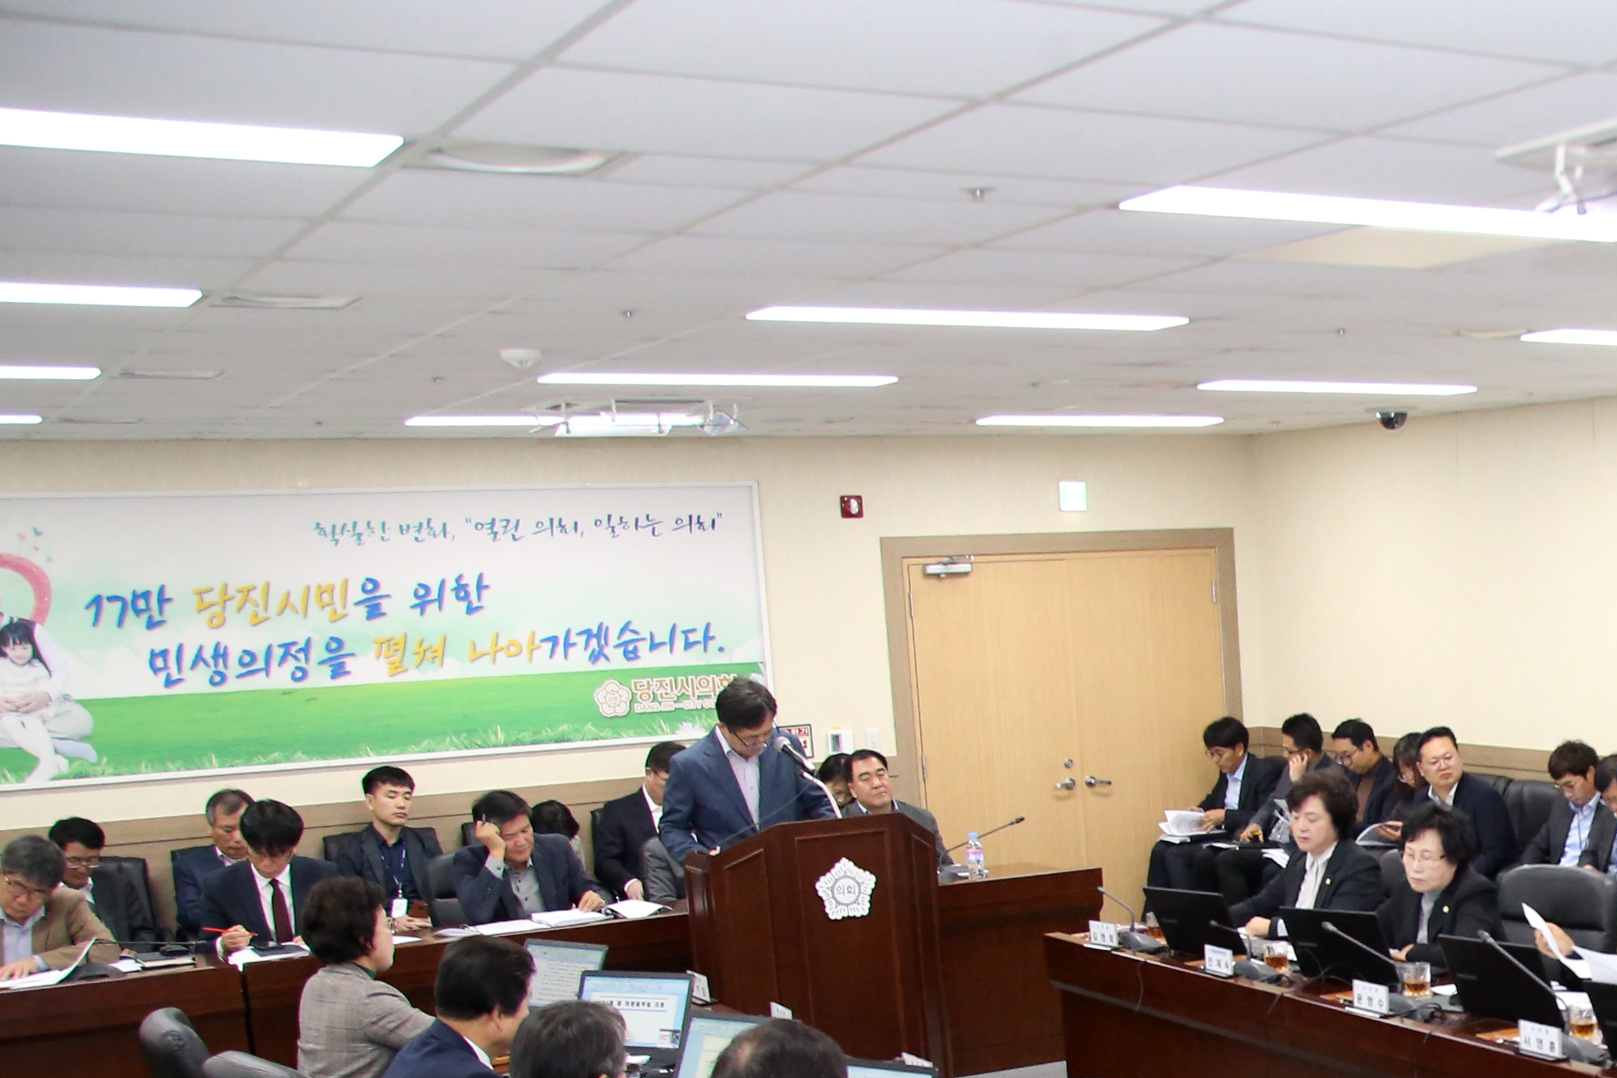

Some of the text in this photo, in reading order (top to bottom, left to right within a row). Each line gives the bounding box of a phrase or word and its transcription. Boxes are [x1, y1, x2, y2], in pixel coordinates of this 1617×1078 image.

[398, 517, 455, 542] 변화,
[532, 517, 584, 537] 의회,
[594, 514, 663, 538] 일하는
[84, 572, 491, 631] 17만 당진시민을 위한
[149, 620, 725, 689] 민생의정을 펼쳐 나아가겠습니다.
[835, 884, 857, 896] 의회
